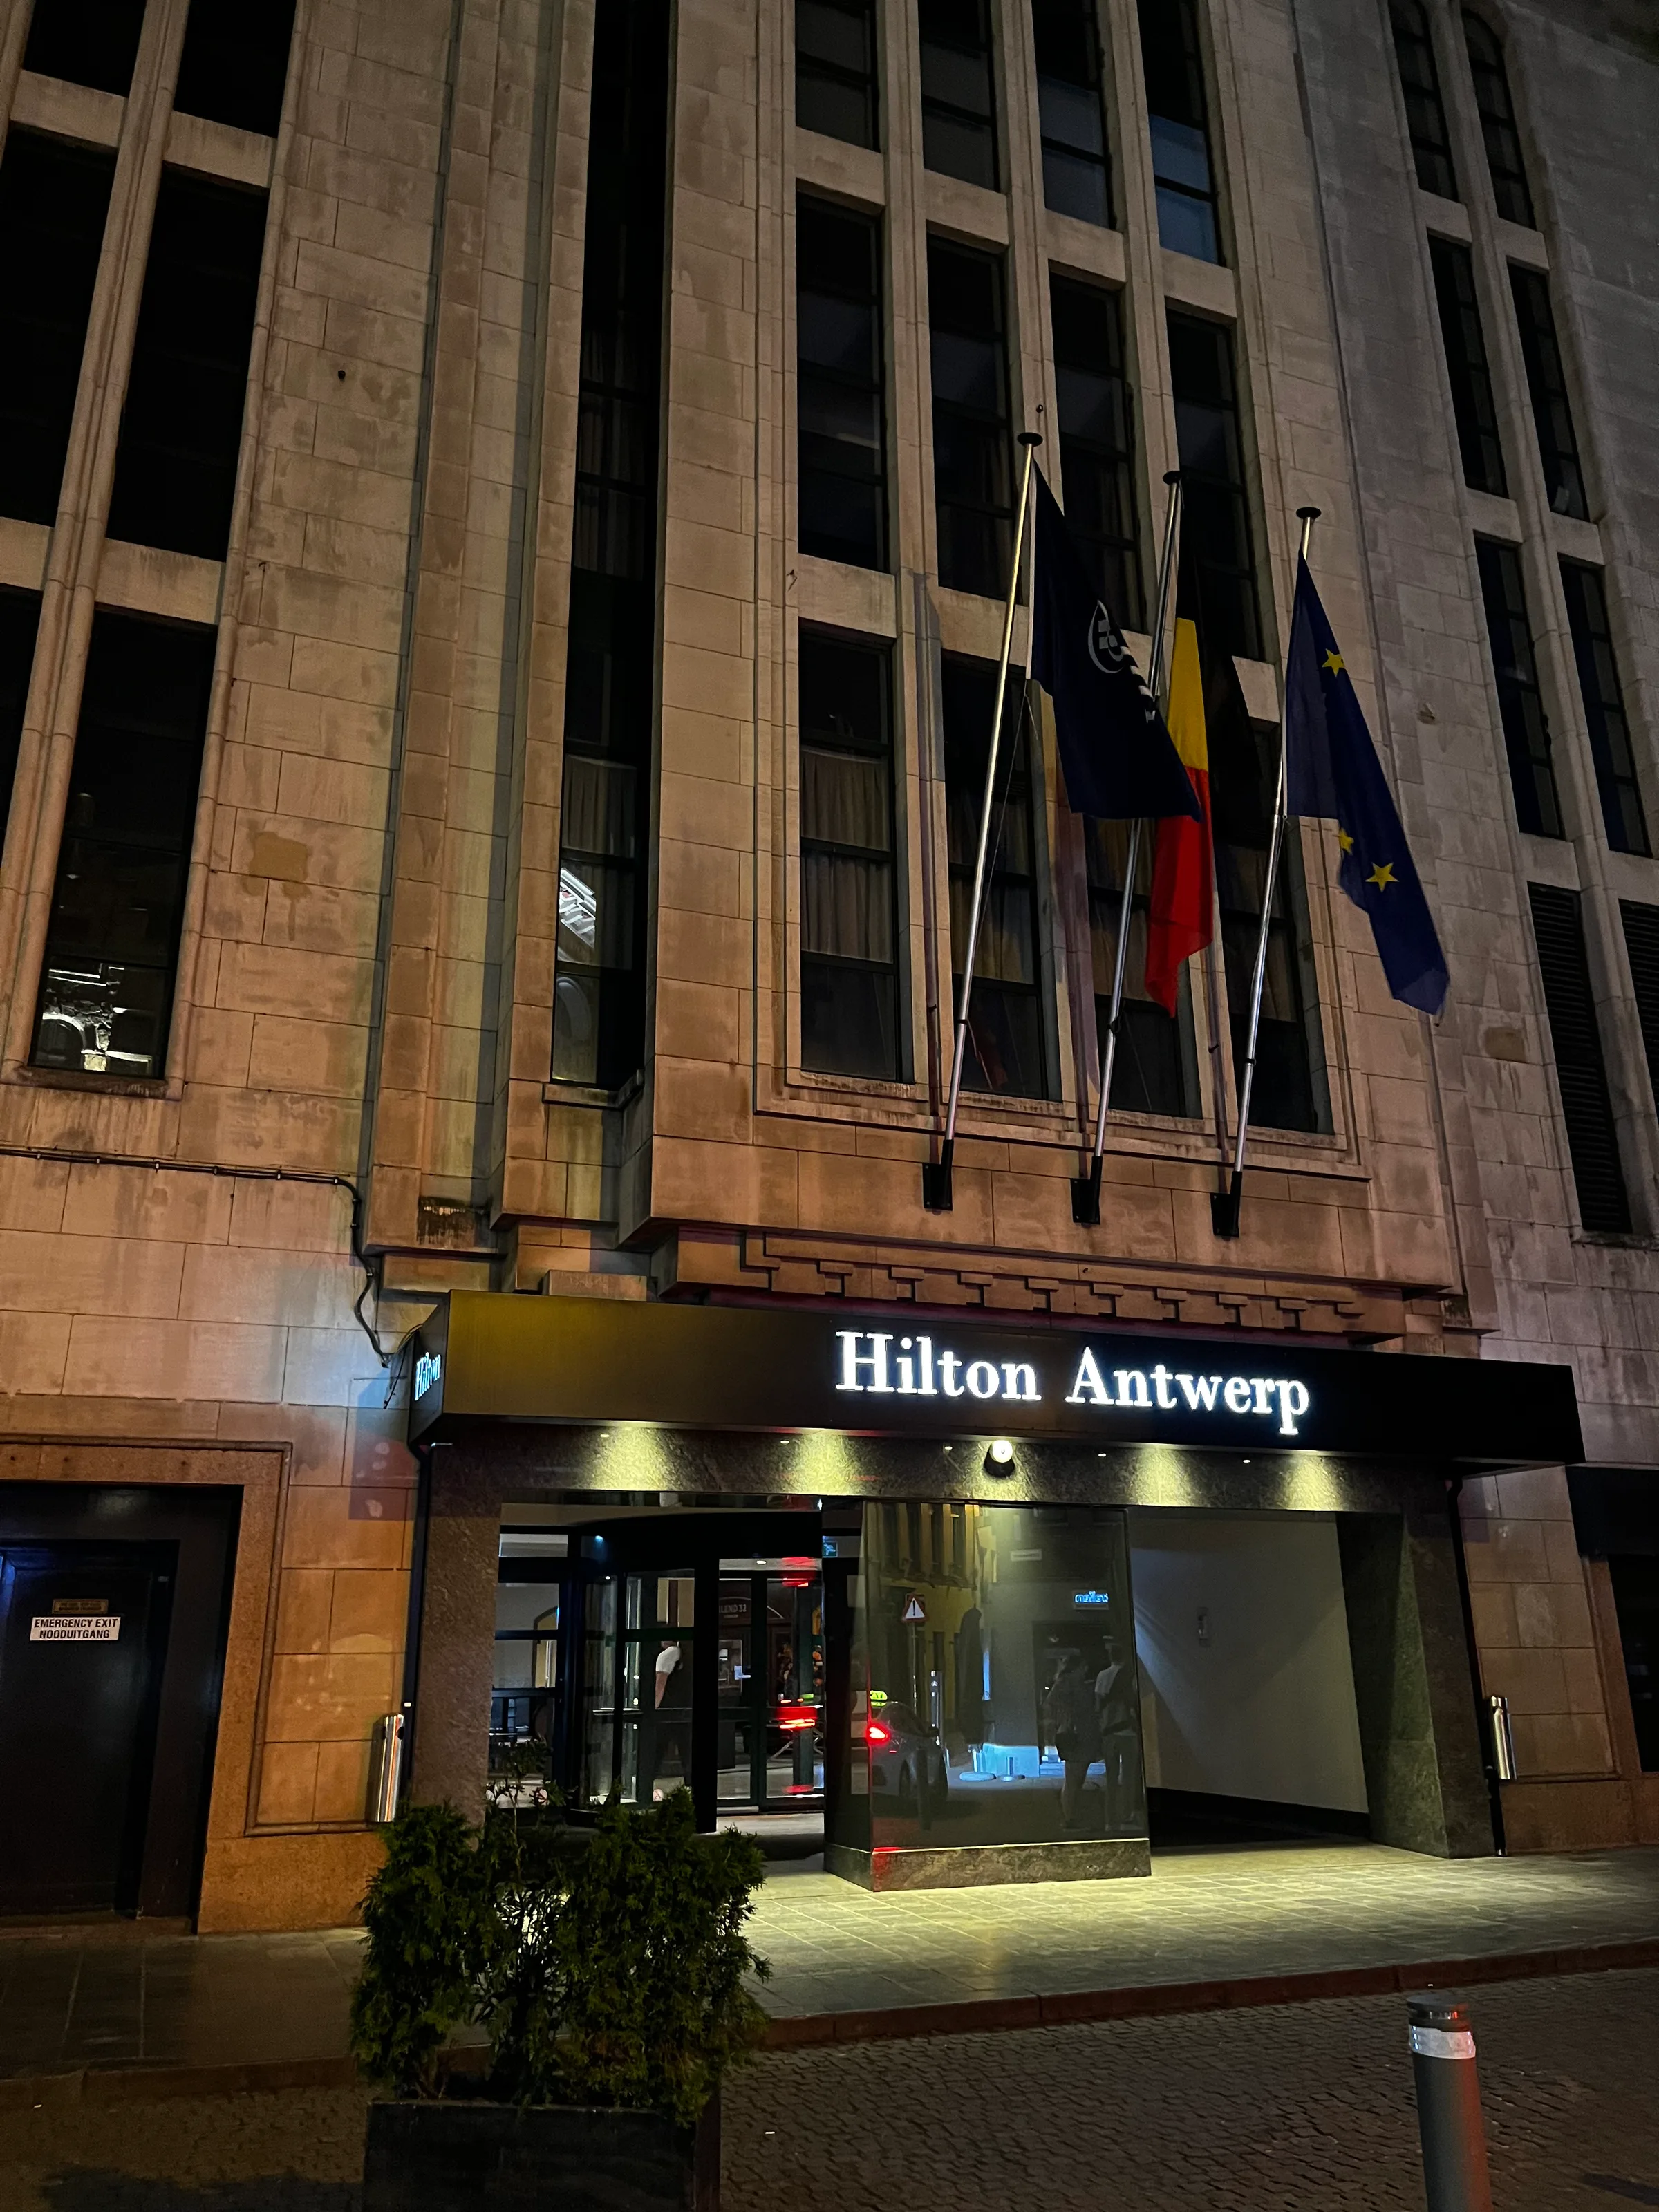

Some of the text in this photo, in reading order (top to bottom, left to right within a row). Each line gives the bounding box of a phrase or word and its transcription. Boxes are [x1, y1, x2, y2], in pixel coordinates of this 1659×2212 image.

[414, 1351, 441, 1401] Hilton
[835, 1331, 1310, 1435] Hilton Antwerp
[34, 1619, 118, 1628] EMERGENCY EXIT
[39, 1630, 110, 1639] NOODUITGANG
